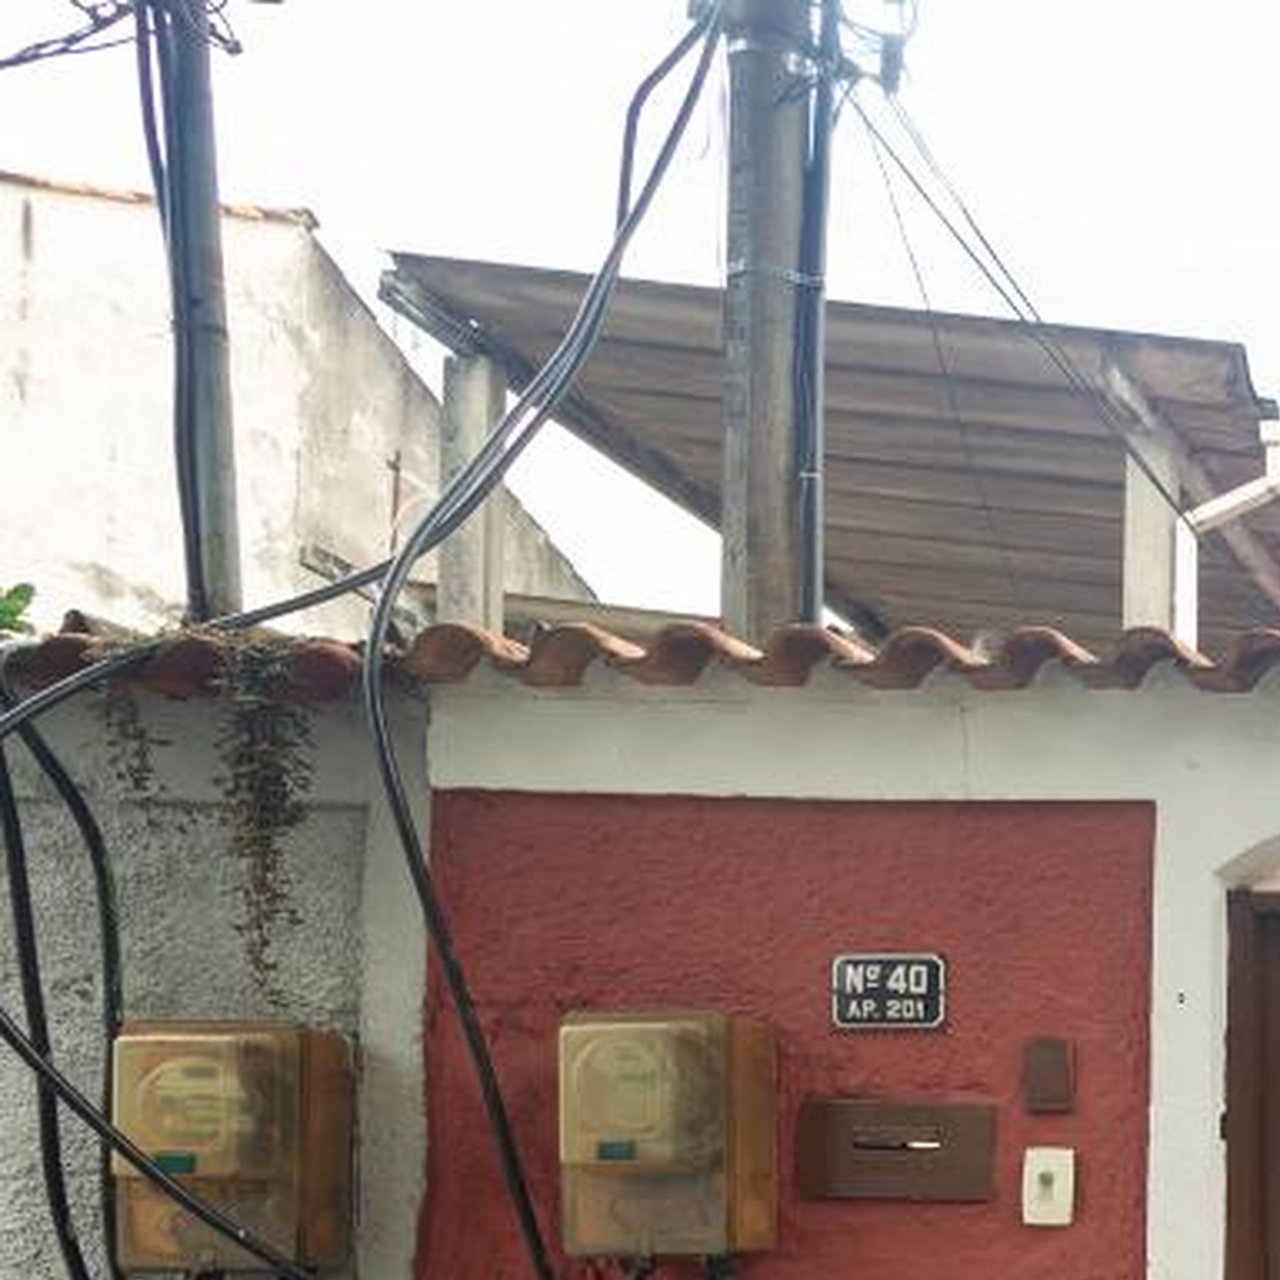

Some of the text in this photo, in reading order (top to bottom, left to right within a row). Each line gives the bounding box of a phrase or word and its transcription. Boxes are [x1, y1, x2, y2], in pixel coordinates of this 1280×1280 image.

[886, 964, 928, 995] 40
[845, 999, 925, 1020] AP. 201
